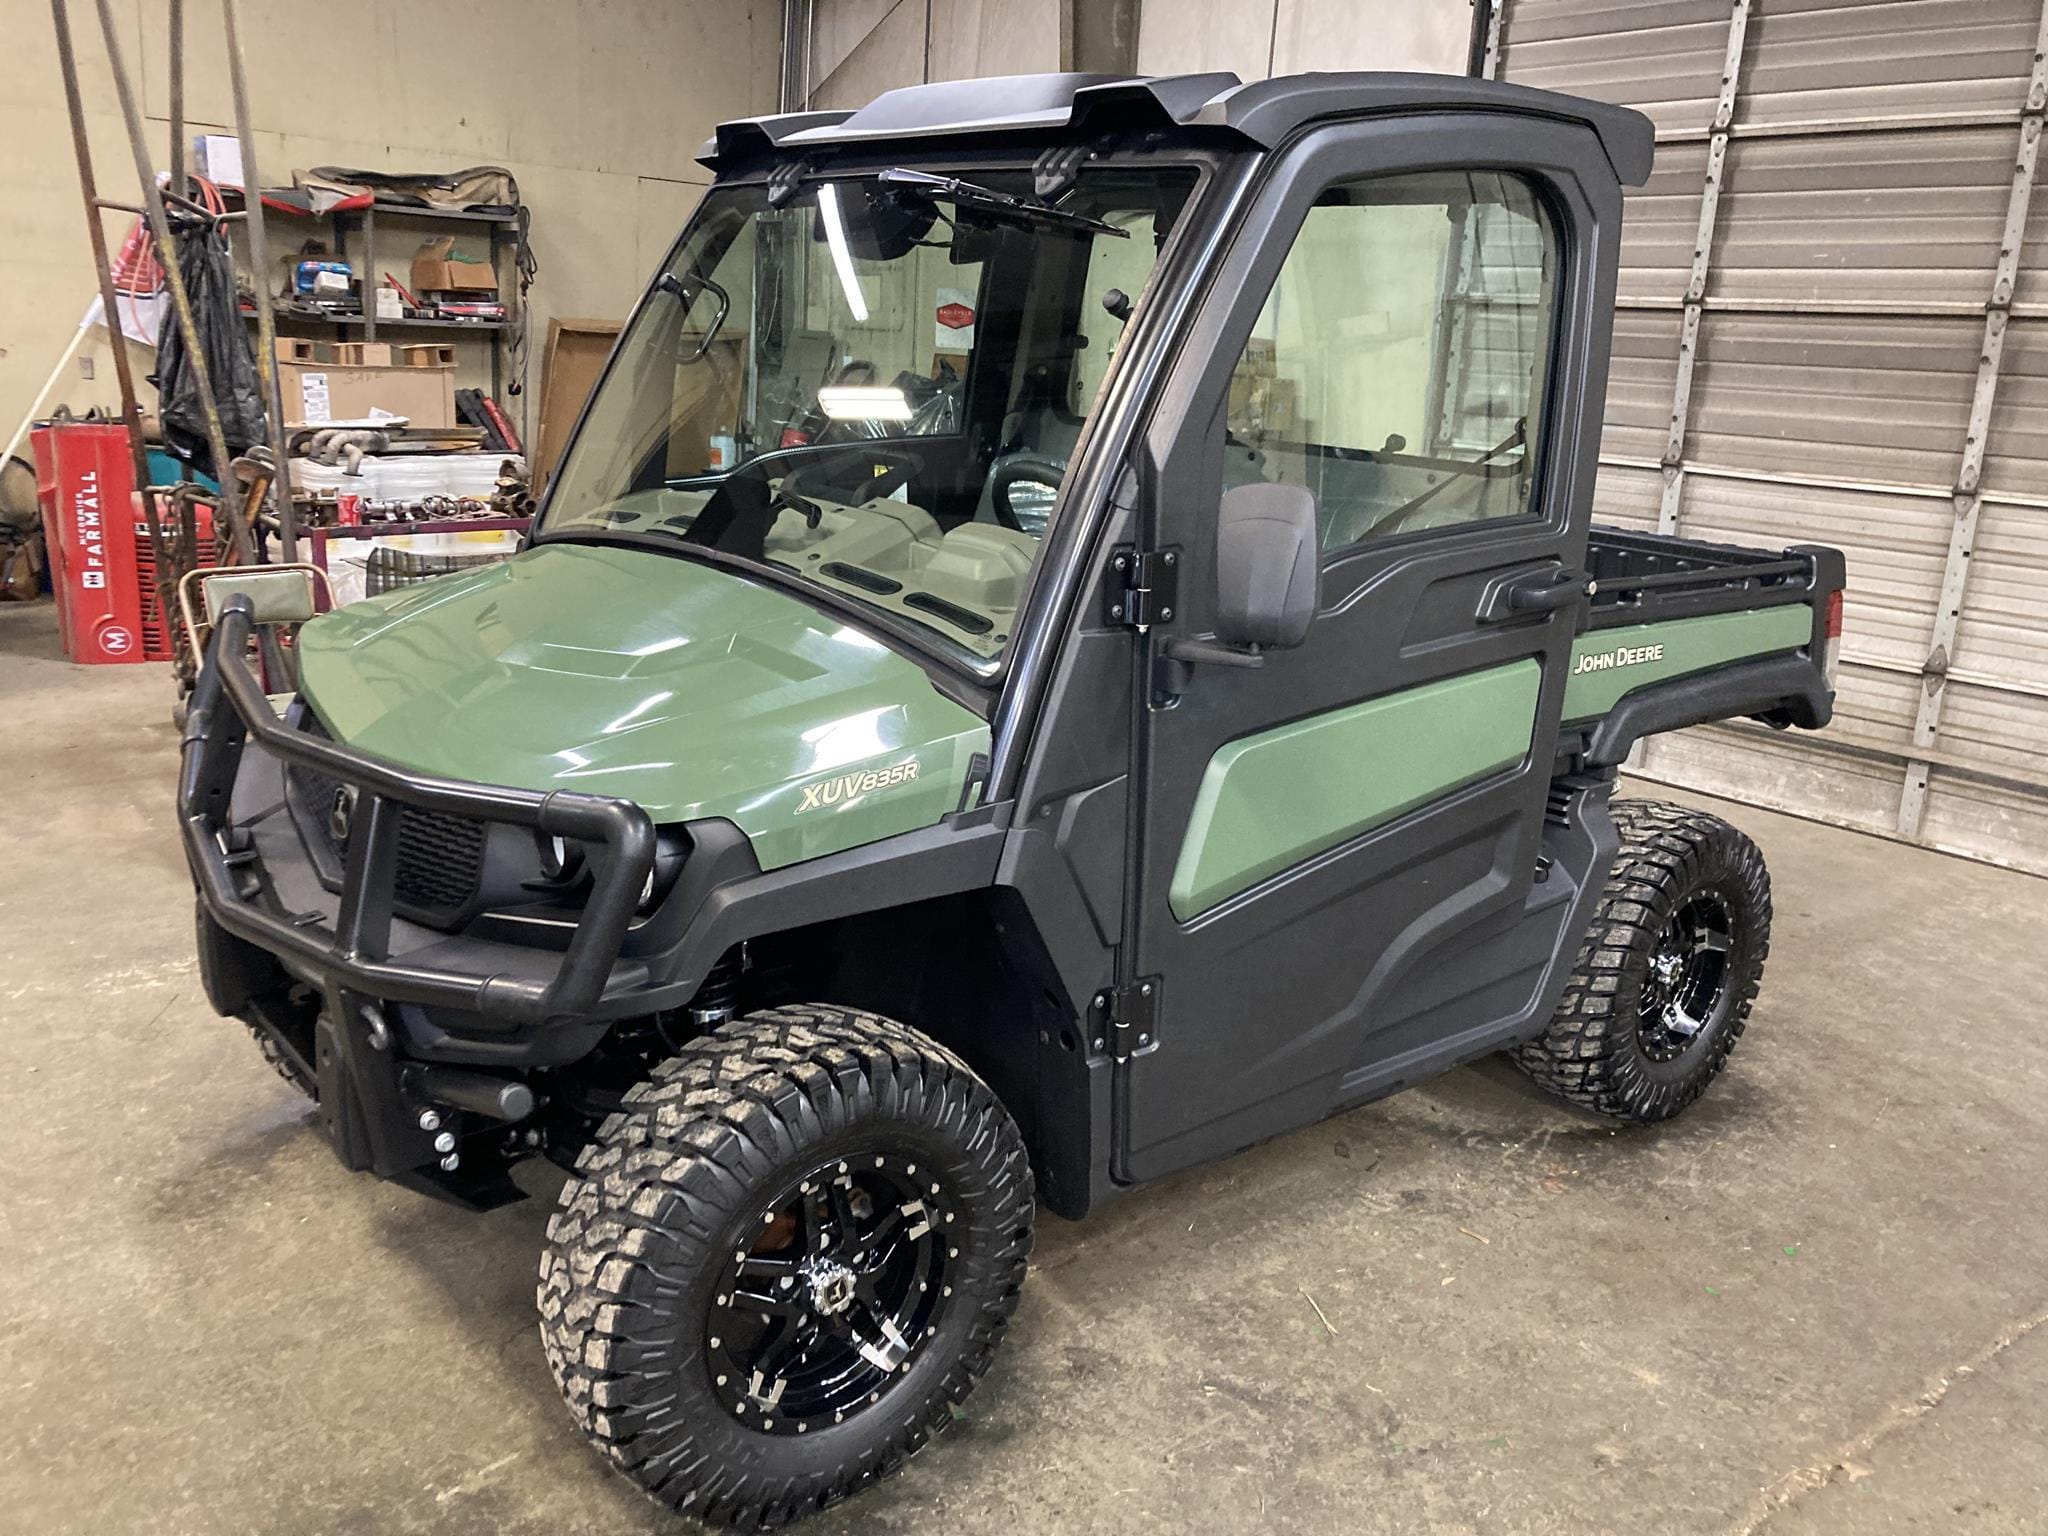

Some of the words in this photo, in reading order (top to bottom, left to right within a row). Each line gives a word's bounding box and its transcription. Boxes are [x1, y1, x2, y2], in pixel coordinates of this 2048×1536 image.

[80, 471, 104, 567] FARMALL
[106, 632, 126, 649] M
[1573, 653, 1616, 675] JOHN
[1615, 643, 1665, 668] DEERE
[797, 761, 919, 812] XUV835R
